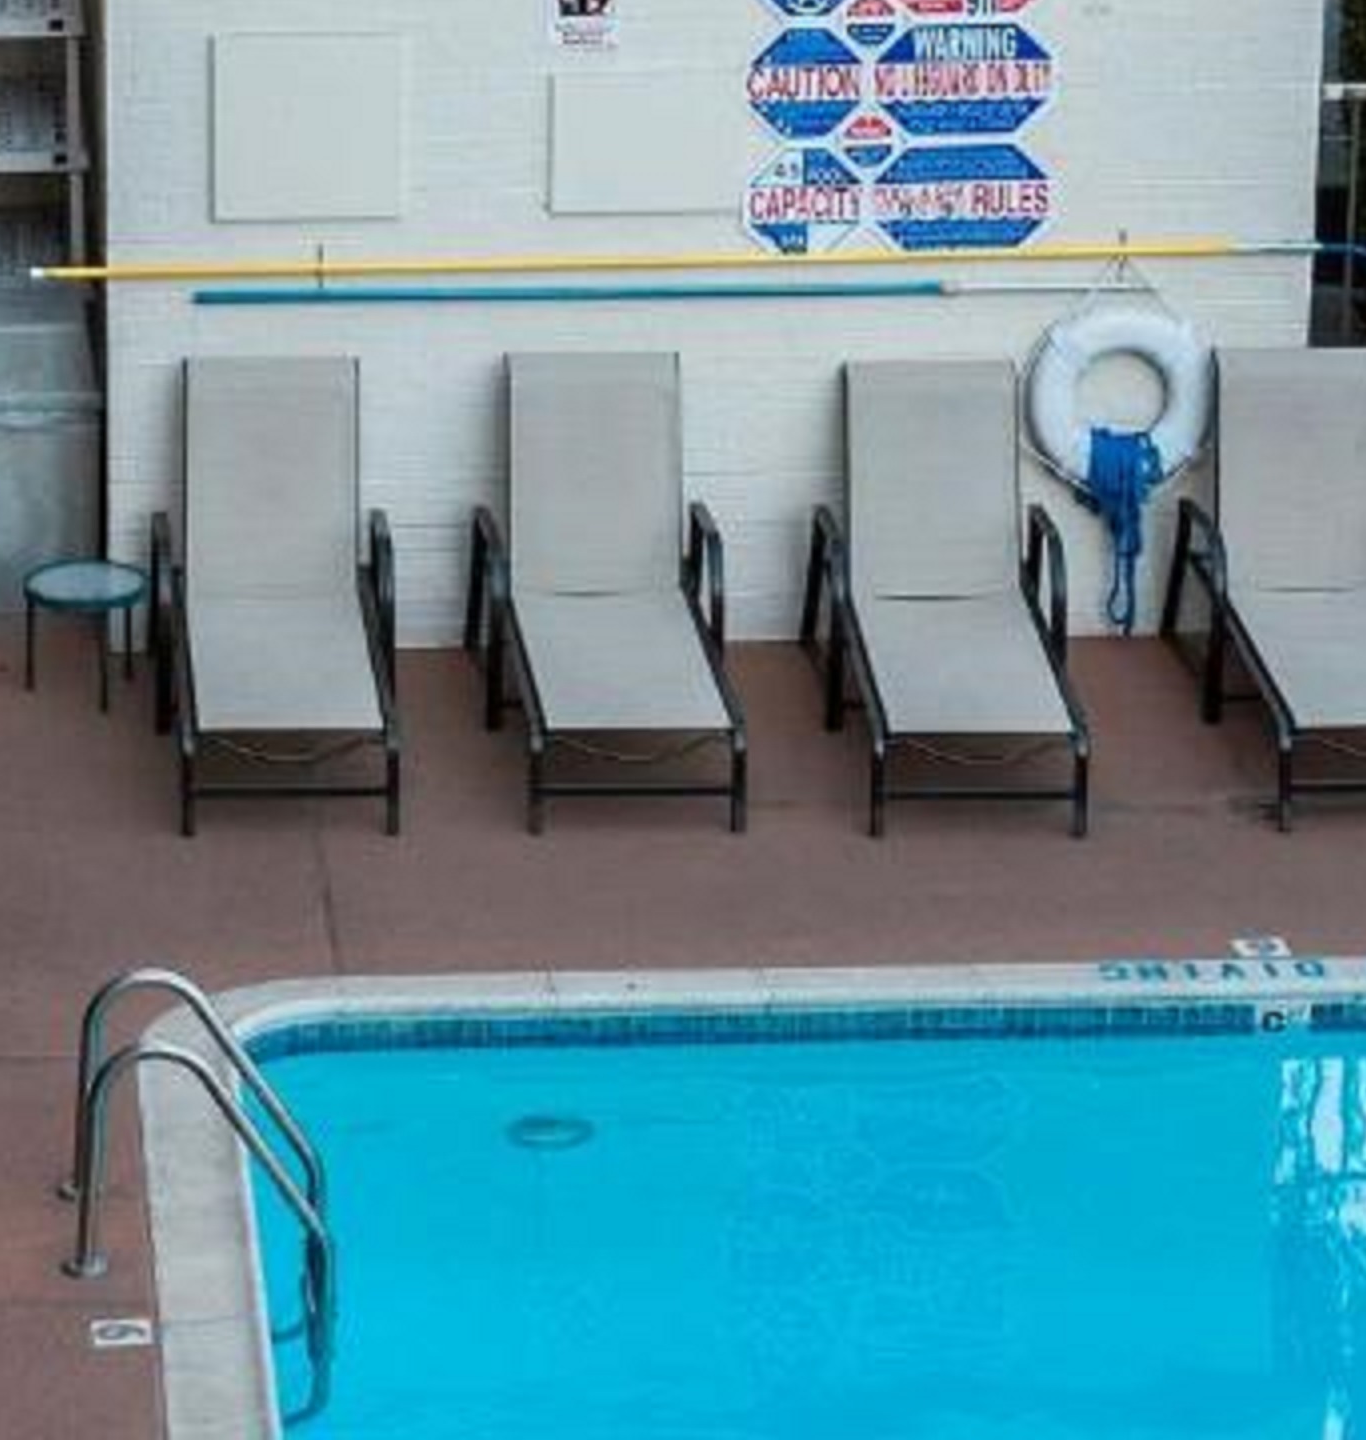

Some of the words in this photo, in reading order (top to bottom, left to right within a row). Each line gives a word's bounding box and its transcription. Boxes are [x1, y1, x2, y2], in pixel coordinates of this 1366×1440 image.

[914, 28, 1017, 59] WARNING
[746, 66, 860, 100] CAUTION
[750, 186, 862, 219] CAPACITY
[972, 183, 1049, 214] RULES
